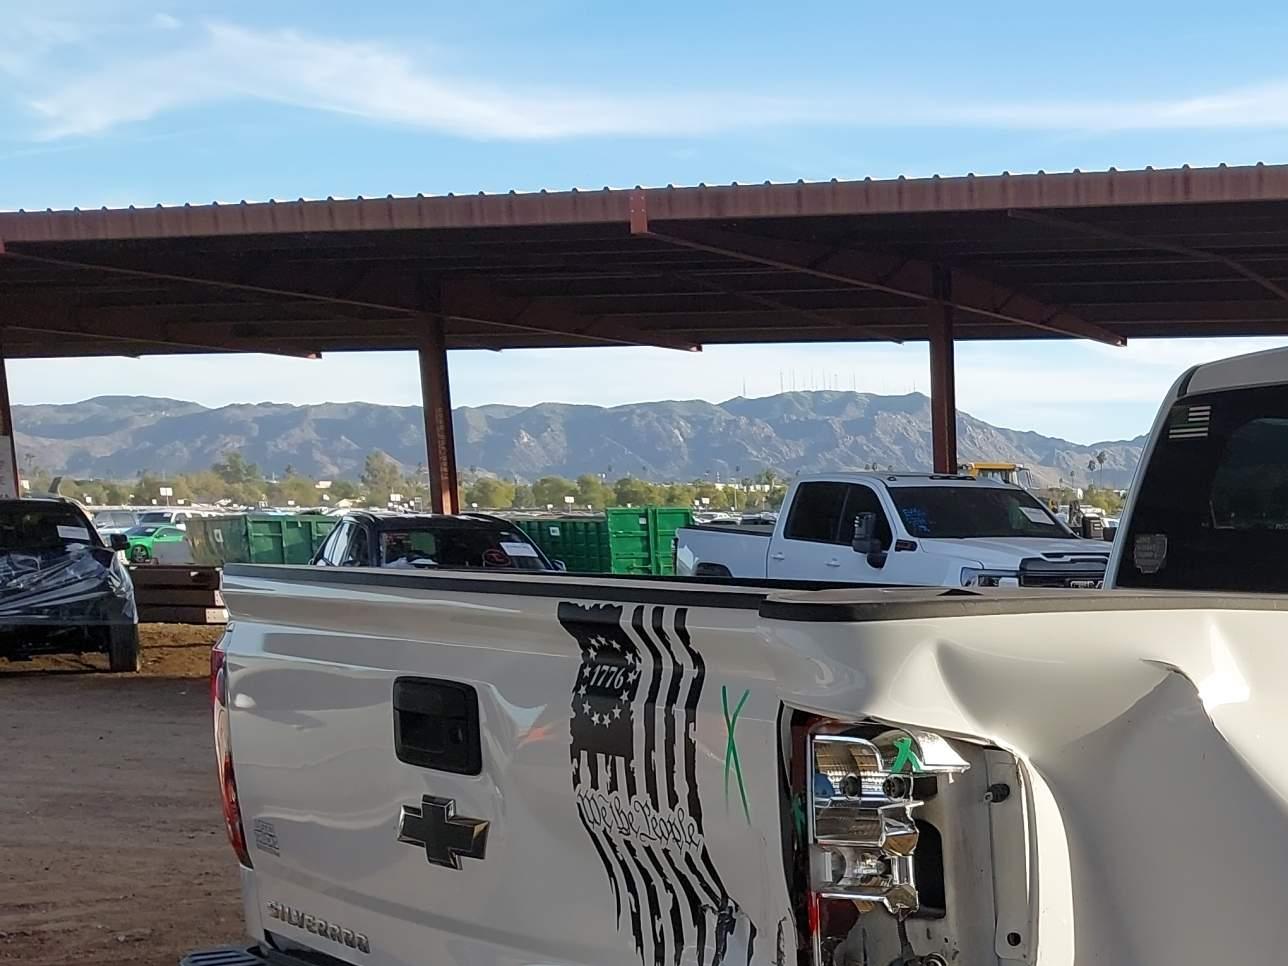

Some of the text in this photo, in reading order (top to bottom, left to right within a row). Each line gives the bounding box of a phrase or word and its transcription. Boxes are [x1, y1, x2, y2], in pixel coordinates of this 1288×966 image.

[589, 664, 625, 689] 1776
[577, 789, 614, 833] We
[634, 799, 701, 855] People
[266, 899, 372, 954] SILVERADO
